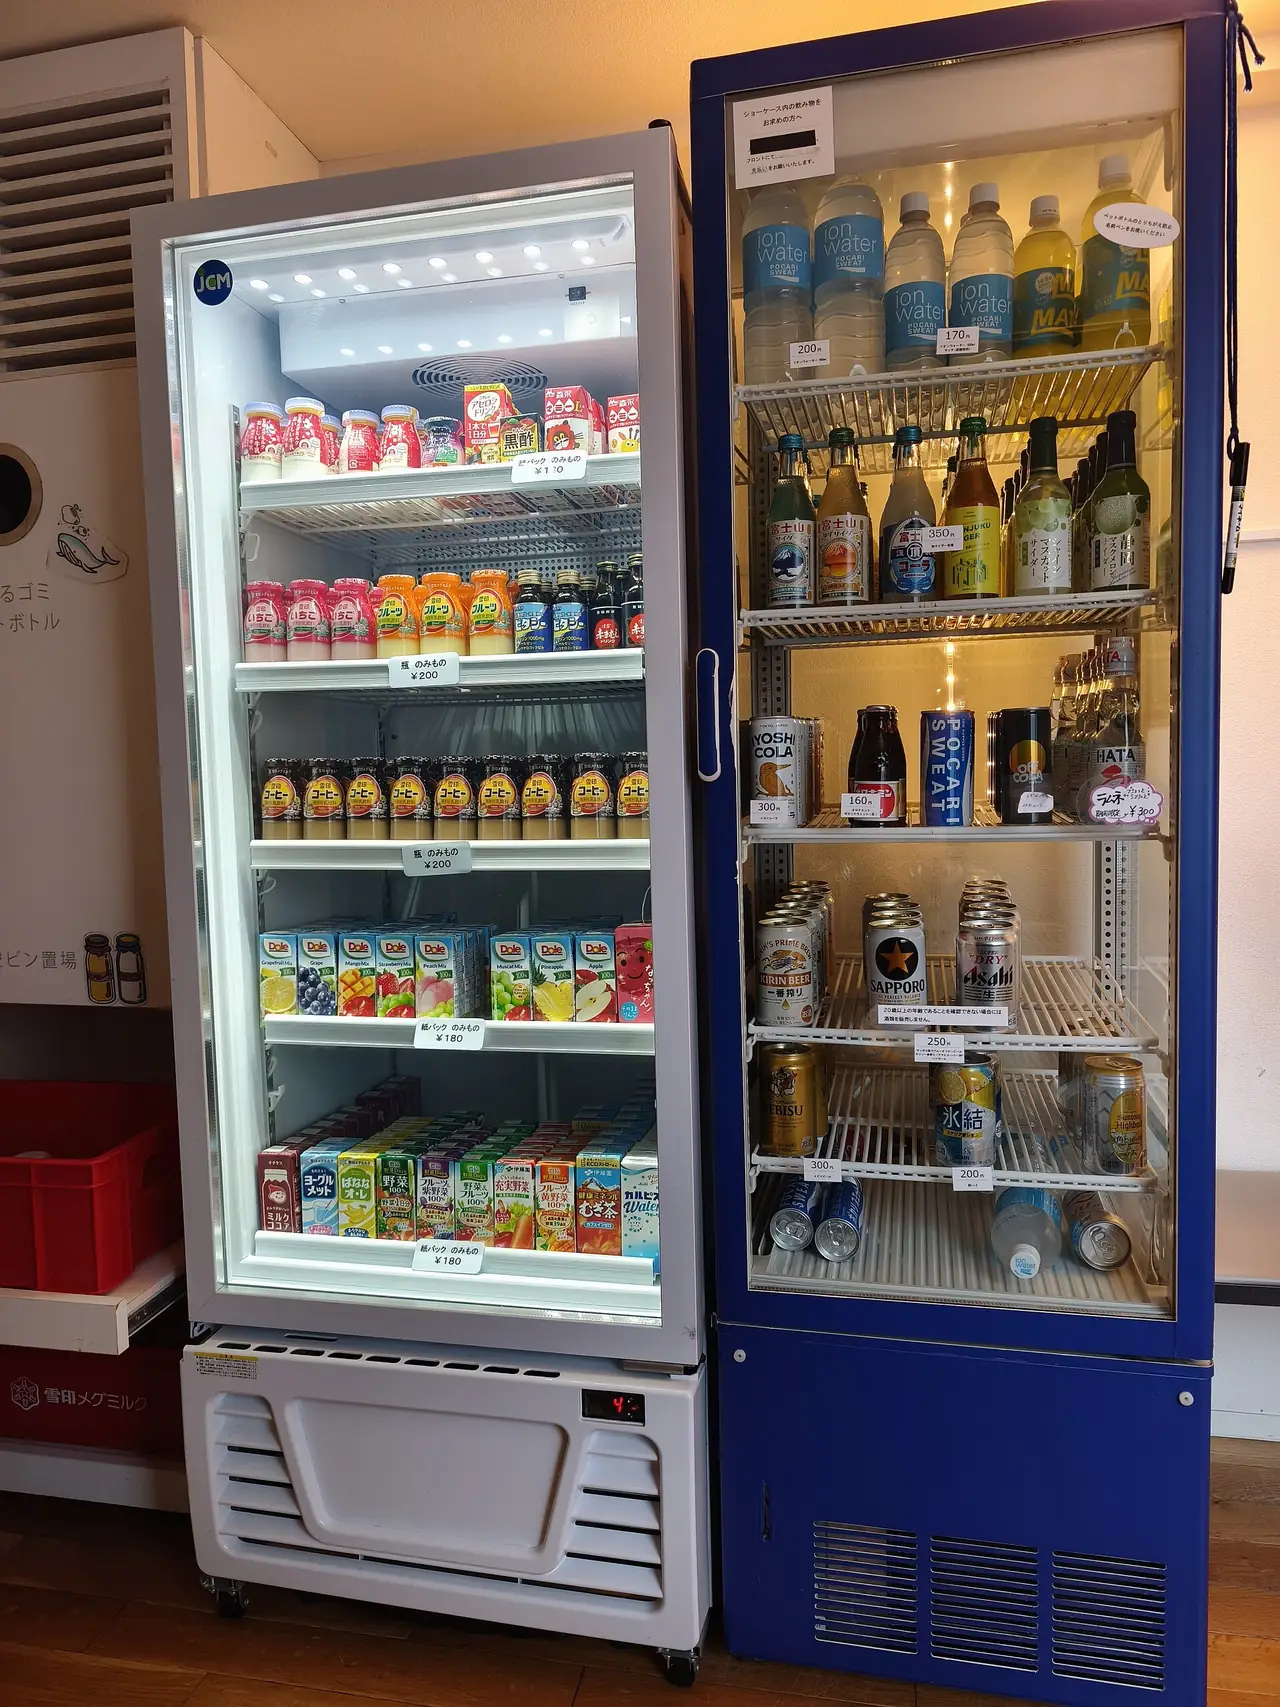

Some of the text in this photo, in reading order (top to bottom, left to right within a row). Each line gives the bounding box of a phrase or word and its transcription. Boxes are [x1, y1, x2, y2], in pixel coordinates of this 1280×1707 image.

[744, 98, 821, 117] ショーケース内の飲み物を
[764, 115, 802, 126] お求めの方へ
[824, 222, 852, 242] ion
[757, 231, 786, 249] ion
[824, 235, 876, 256] water
[757, 243, 807, 263] water
[960, 283, 990, 302] ion
[896, 290, 924, 308] ion
[960, 296, 1011, 316] water
[896, 302, 944, 322] water
[946, 330, 970, 340] 170円
[798, 344, 822, 354] 200円
[504, 431, 534, 450] 黒酢
[519, 457, 546, 466] パック
[771, 523, 804, 536] 富士山
[822, 518, 856, 531] 富士山
[964, 522, 991, 532] NJUKU
[900, 531, 922, 543] 富士
[929, 529, 954, 538] 350円
[964, 533, 980, 541] GER
[1030, 538, 1038, 576] サイダー
[1040, 539, 1050, 582] マスカット
[1109, 536, 1117, 578] マスクメロン
[899, 560, 930, 572] コーラ
[379, 607, 402, 617] フルーツ
[424, 605, 449, 614] フルーツ
[472, 602, 497, 614] フルーツ
[248, 614, 273, 622] いちご
[290, 611, 316, 620] いちご
[415, 659, 447, 668] のみもの
[411, 671, 438, 680] ¥200
[752, 732, 796, 747] IYOSHI
[754, 746, 793, 759] COLA
[1097, 749, 1136, 763] HATA
[932, 720, 946, 811] SWEAT
[946, 719, 960, 823] POCARI
[264, 790, 288, 799] コーヒー
[312, 789, 339, 799] コーヒー
[350, 789, 373, 798] コーヒー
[393, 788, 418, 798] コーヒー
[440, 788, 466, 798] コーヒー
[484, 788, 511, 798] コーヒー
[525, 788, 549, 797] コーヒー
[578, 786, 604, 796] コーヒー
[1097, 791, 1124, 806] ラムネ
[758, 803, 780, 811] 300円
[428, 848, 459, 857] のみもの
[425, 860, 451, 869] ¥200
[268, 942, 288, 951] Dole
[308, 941, 328, 951] Dole
[348, 942, 369, 951] Dole
[386, 942, 406, 951] Dole
[424, 944, 446, 954] Dole
[500, 944, 521, 954] Dole
[541, 945, 562, 954] Dole
[586, 943, 607, 953] Dole
[0, 950, 77, 970] ビン置場
[760, 974, 810, 985] KIRIN BEER
[964, 965, 1013, 986] Asahi
[871, 979, 925, 994] SAPPORO
[768, 988, 803, 997] 一番搾り
[983, 990, 996, 999] 生
[884, 1007, 1001, 1015] 20歳以上の年齢であることを確認できない場合には
[421, 1023, 480, 1032] 紙パック のみもの
[436, 1034, 463, 1043] ¥180
[928, 1037, 951, 1046] 250円
[770, 1105, 803, 1116] EBISU
[943, 1106, 983, 1130] 氷結
[812, 1161, 834, 1169] 300円
[960, 1170, 984, 1178] 200円
[304, 1175, 334, 1186] ヨーグル
[342, 1177, 370, 1188] ばなな
[383, 1175, 408, 1188] 野菜
[307, 1186, 331, 1196] メット
[496, 1180, 529, 1192] 充実野菜
[345, 1189, 367, 1199] オ・レ
[422, 1187, 448, 1196] 紫野菜
[460, 1191, 488, 1199] フルーツ
[541, 1193, 568, 1202] 黄野菜
[579, 1200, 618, 1219] むぎ茶
[268, 1213, 289, 1221] ミルク
[268, 1222, 289, 1230] ココア
[420, 1245, 479, 1255] 紙パック のみもの
[435, 1256, 461, 1265] ¥180
[44, 1387, 147, 1412] 雪印メグミルク
[613, 1397, 623, 1412] 4
